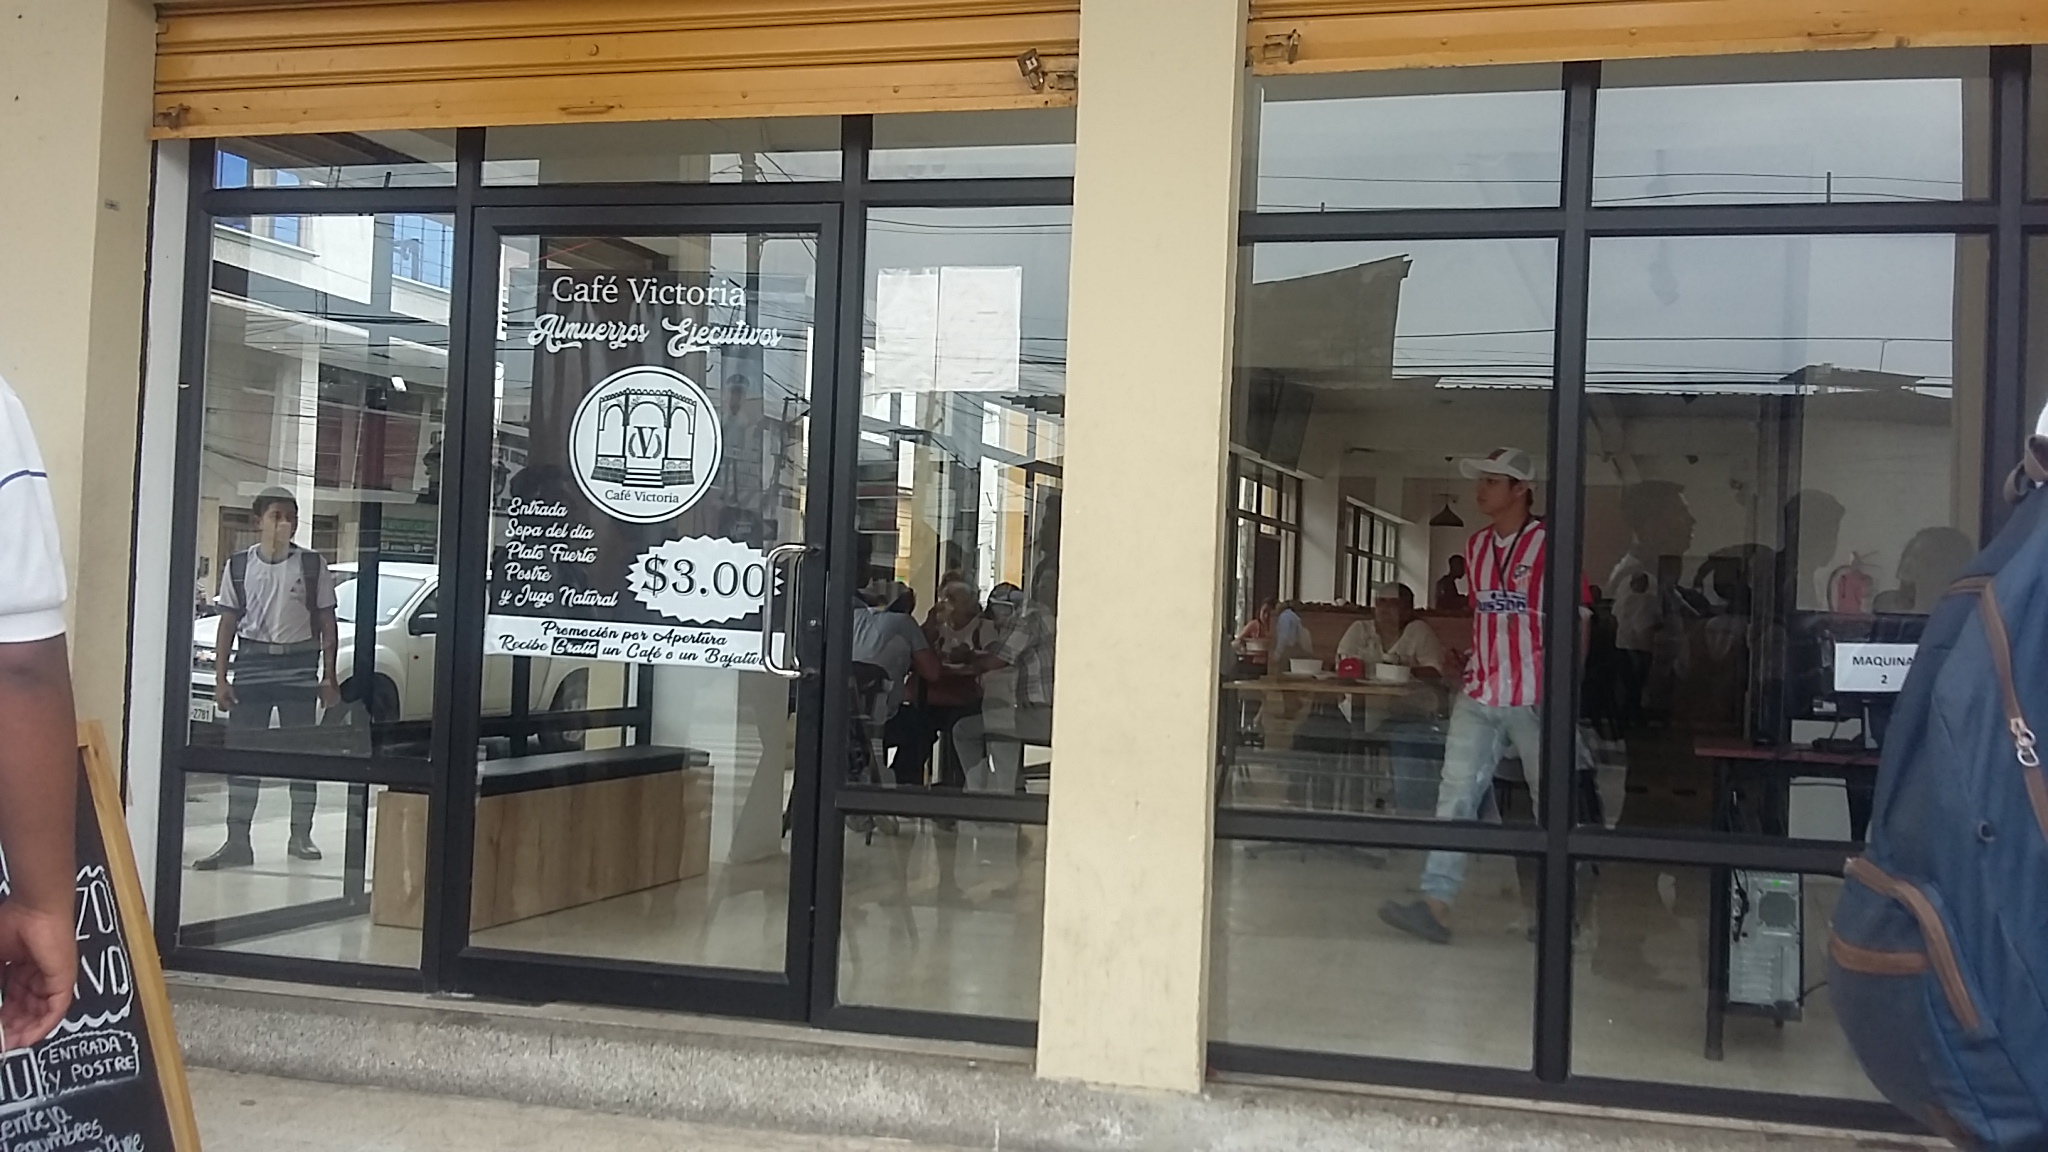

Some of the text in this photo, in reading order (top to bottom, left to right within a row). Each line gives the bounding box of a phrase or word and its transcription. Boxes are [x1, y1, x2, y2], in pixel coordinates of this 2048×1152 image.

[552, 275, 747, 307] Café Victoria
[528, 314, 782, 357] Almuerzos Ejecutivos
[508, 497, 568, 517] Entrada
[604, 489, 679, 503] Café Victoria
[505, 518, 543, 541] Sopa
[545, 522, 569, 538] del
[505, 541, 598, 563] Plato Fuerte
[504, 562, 552, 582] Postre
[642, 554, 766, 600] $3.00
[498, 584, 618, 608] y Jugo Natural
[541, 620, 728, 646] Promoción por Apertura
[499, 634, 549, 651] Recibe
[602, 646, 622, 656] un
[626, 643, 661, 662] Café
[666, 651, 674, 660] o
[680, 651, 698, 661] un
[1881, 675, 1888, 684] 2
[49, 1035, 122, 1064] ENTRADA
[71, 1055, 135, 1082] POSTRE
